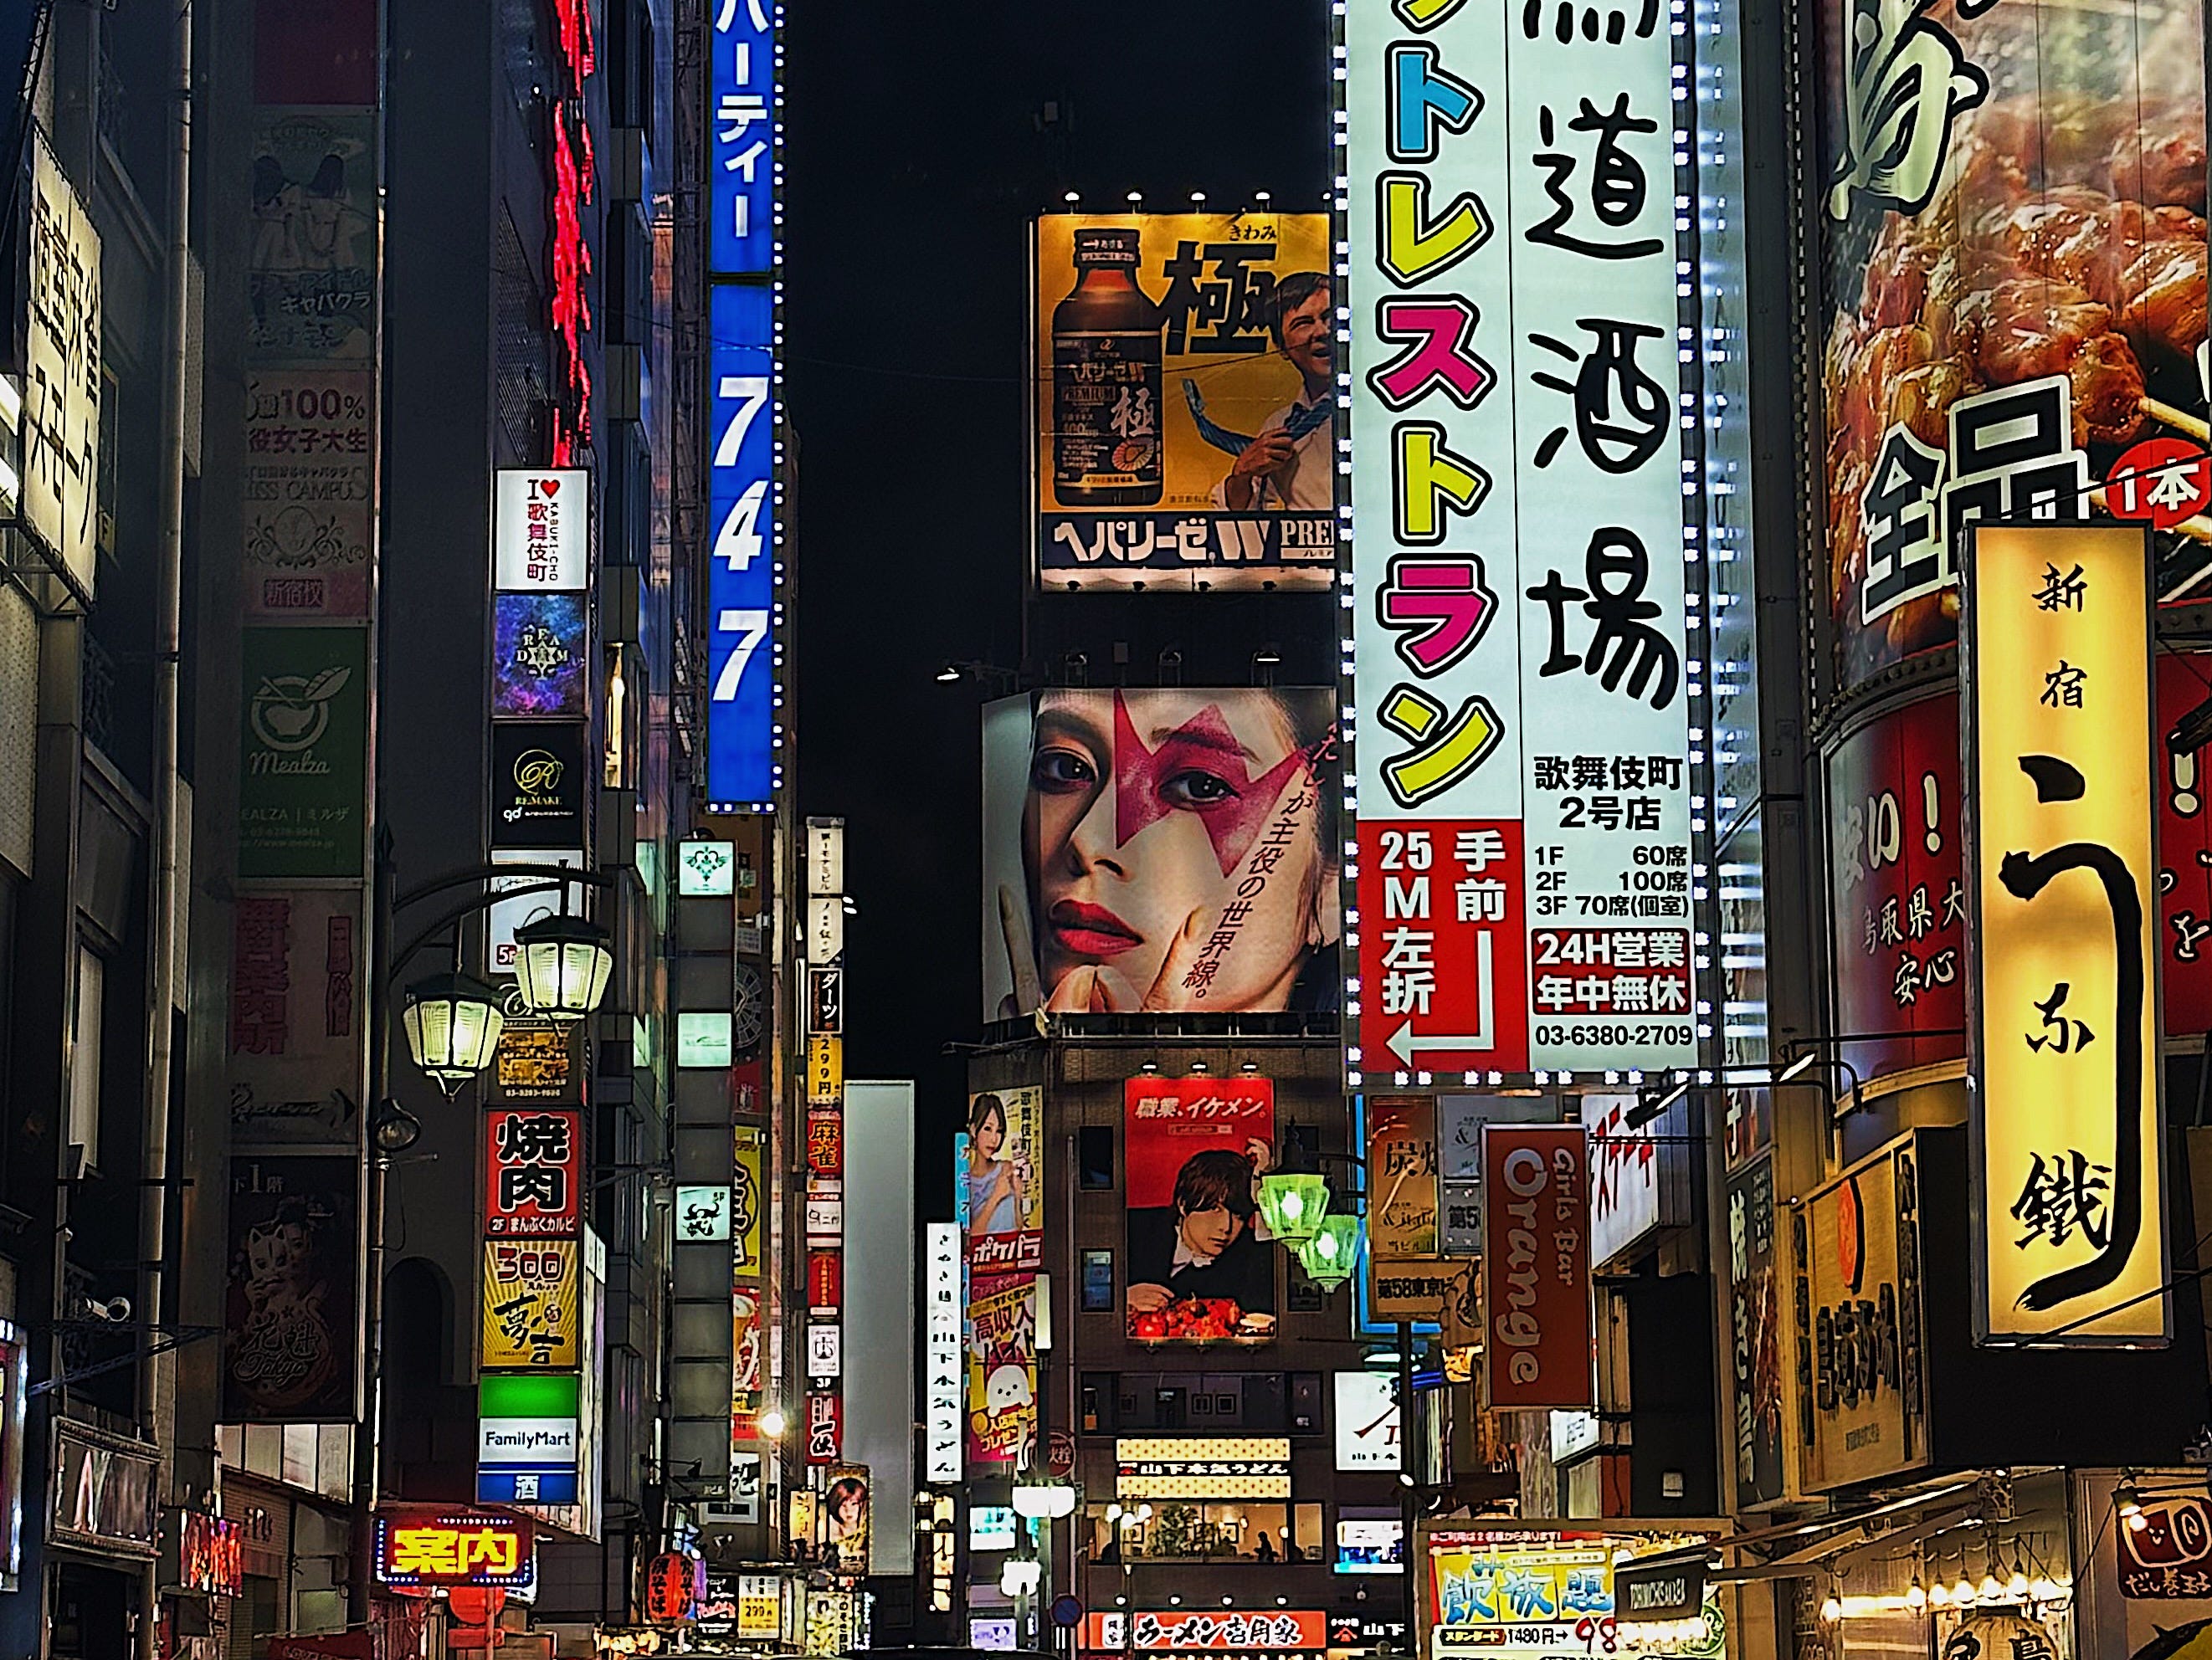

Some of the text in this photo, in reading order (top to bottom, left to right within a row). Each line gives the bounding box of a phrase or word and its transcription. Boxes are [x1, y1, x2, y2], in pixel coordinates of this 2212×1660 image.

[1228, 226, 1276, 241] きわみ
[1163, 241, 1276, 355] 極
[1366, 0, 1505, 809] トレストラン
[527, 503, 548, 582] 歌舞伎町
[549, 502, 559, 582] KABUKI-CHO
[1054, 517, 1334, 561] ヘパリーゼ W PRE
[249, 749, 331, 776] Mealza
[1534, 756, 1683, 792] 歌舞伎町
[1559, 797, 1661, 831] 2号店
[1535, 846, 1687, 867] 1F 60席
[1454, 830, 1506, 921] 手前
[1536, 872, 1688, 892] 2F 100席
[1536, 895, 1689, 919] 3F 70席(個室)
[1536, 933, 1686, 968] 24H営業
[822, 972, 837, 1019] ダーツ
[1536, 976, 1686, 1012] 年中無休
[1535, 1025, 1693, 1046] 03-6380-2709
[497, 1113, 570, 1212] 焼肉
[809, 1122, 839, 1168] 麻雀
[1449, 1205, 1481, 1229] 第5
[973, 1233, 1042, 1263] ポケパラ
[1553, 1227, 1581, 1286] Bar
[1496, 1148, 1549, 1386] Orange
[485, 1431, 571, 1447] FamilyMart
[515, 1474, 539, 1500] 酒
[391, 1527, 519, 1575] 案内
[1507, 1627, 1555, 1645] 1480円
